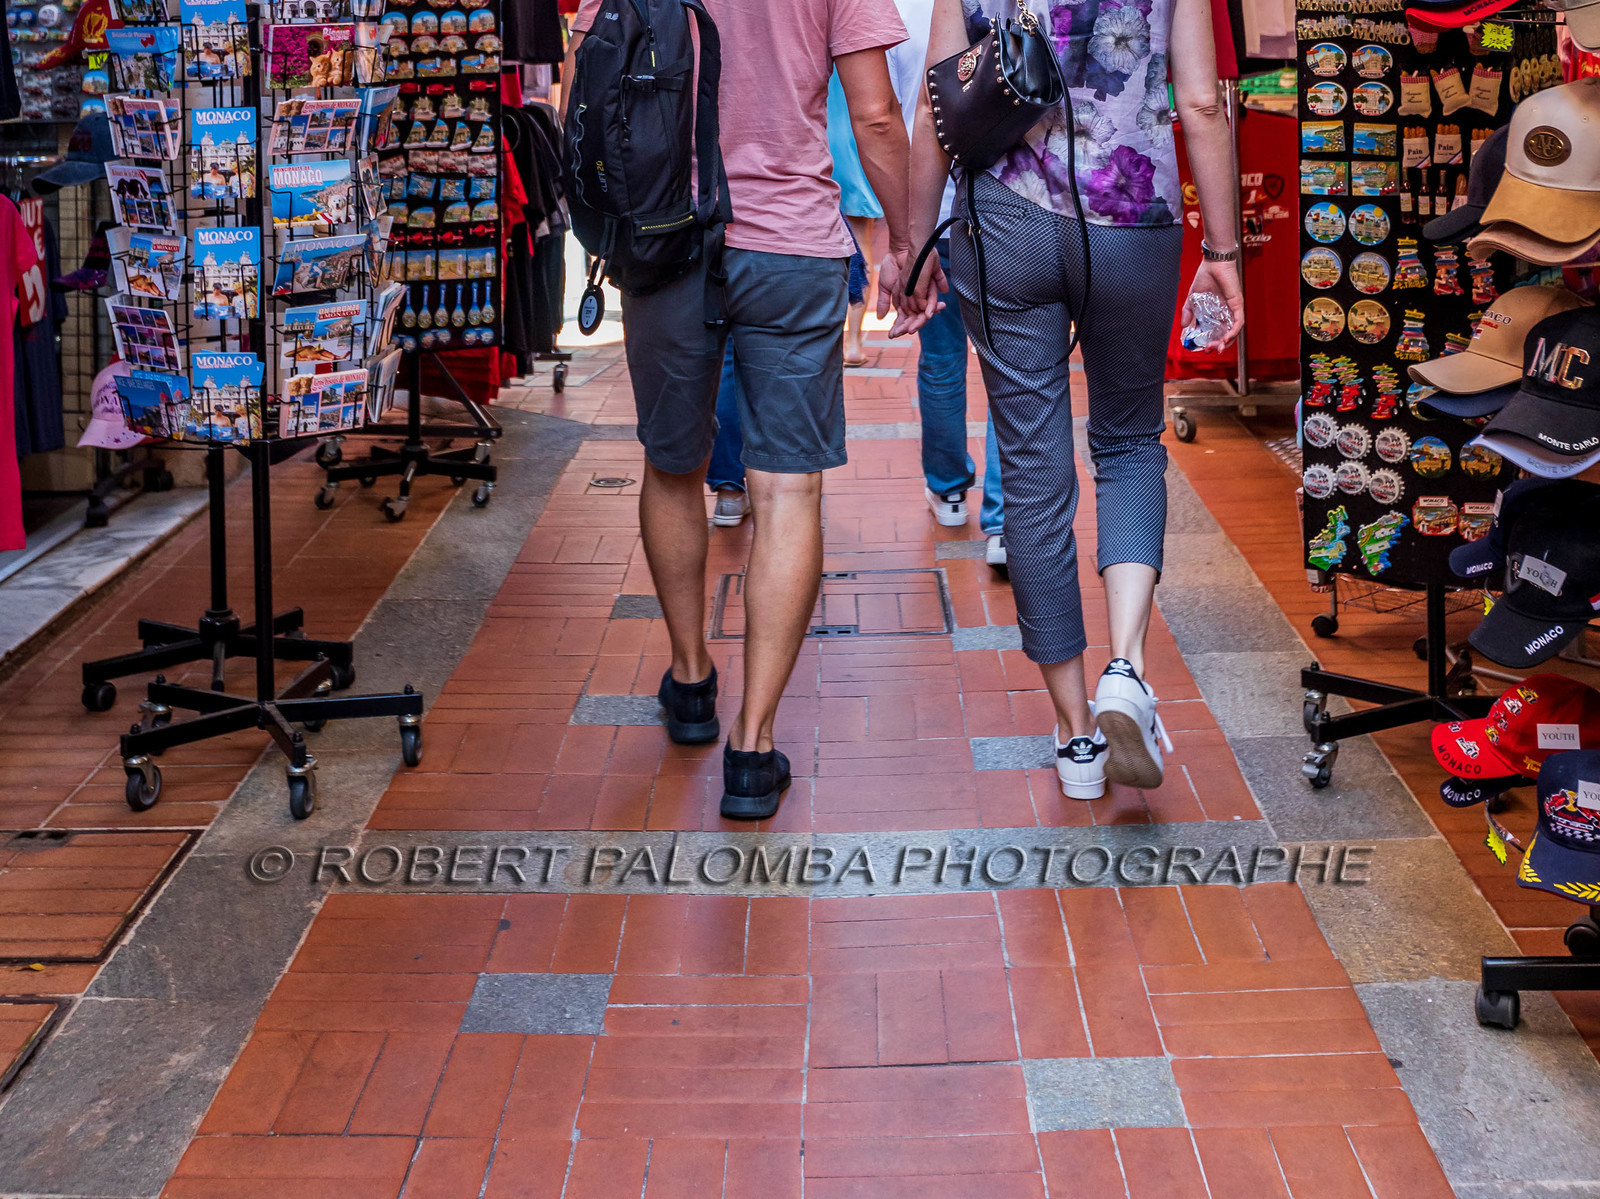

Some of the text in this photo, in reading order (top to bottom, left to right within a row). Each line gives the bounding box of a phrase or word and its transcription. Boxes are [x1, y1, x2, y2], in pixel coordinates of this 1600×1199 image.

[1297, 0, 1350, 13] MONACO
[1298, 23, 1353, 41] MONACO
[1353, 28, 1411, 46] MONACO
[196, 111, 250, 122] MONACO
[273, 170, 323, 186] MONACO
[198, 231, 253, 241] MONACO
[294, 238, 355, 252] MONACO
[196, 356, 252, 367] MONACO
[1527, 337, 1590, 390] MC
[1538, 433, 1600, 451] MONTE CARLO
[1526, 457, 1558, 474] MONTE
[1466, 562, 1493, 575] MONACO
[1524, 625, 1564, 656] MONACO
[1542, 732, 1575, 741] YOUTH
[1437, 744, 1482, 775] MONACO
[1443, 785, 1481, 803] MONACO
